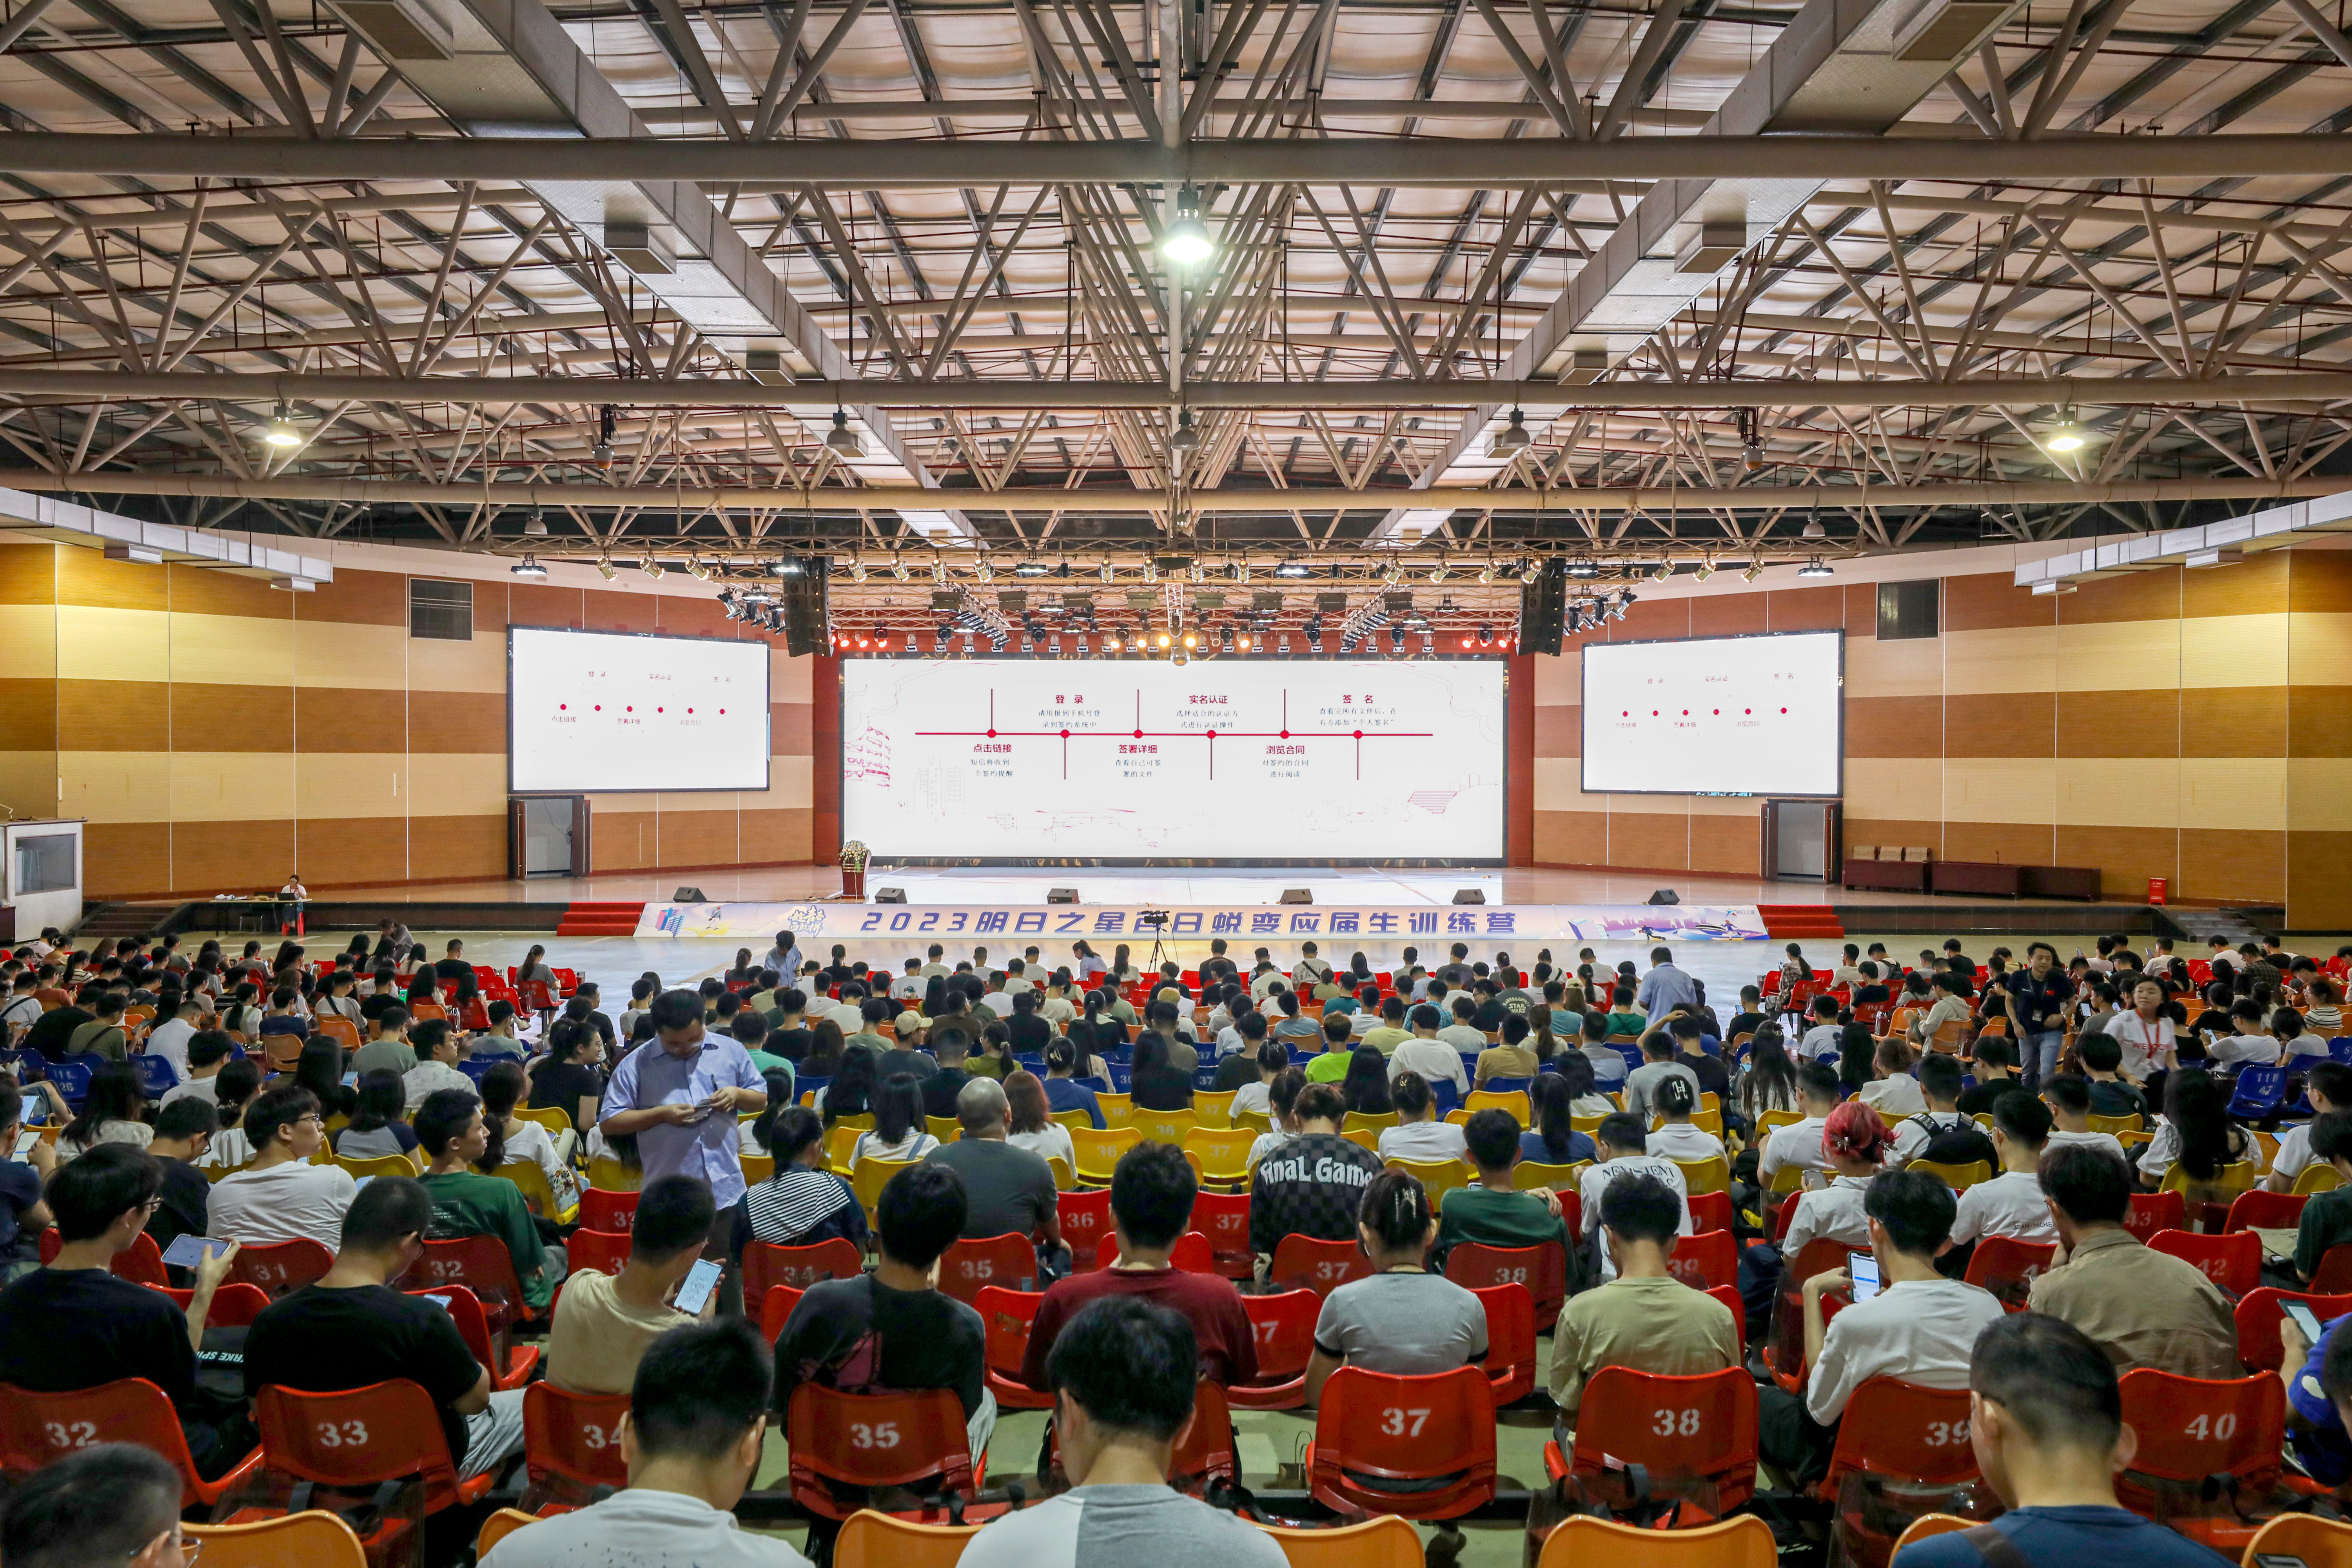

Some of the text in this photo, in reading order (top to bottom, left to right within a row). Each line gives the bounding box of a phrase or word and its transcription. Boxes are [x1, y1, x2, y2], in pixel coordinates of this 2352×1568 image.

[1189, 695, 1228, 704] 实名认证
[973, 743, 1012, 753] 点击链接
[1118, 744, 1157, 754] 签署详细
[1266, 745, 1305, 755] 浏览合同
[1198, 1051, 1210, 1060] 37
[59, 1082, 74, 1092] 26
[1198, 1076, 1214, 1085] 37
[1209, 1145, 1230, 1158] 37
[1316, 1157, 1373, 1187] Game
[1066, 1212, 1094, 1229] 36
[1216, 1214, 1244, 1230] 37
[2125, 1211, 2151, 1227] 43
[255, 1263, 287, 1281] 31
[430, 1261, 463, 1278] 32
[783, 1266, 815, 1283] 34
[961, 1259, 991, 1278] 35
[1317, 1261, 1349, 1280] 37
[1494, 1267, 1526, 1283] 38
[2195, 1258, 2226, 1276] 42
[218, 1352, 243, 1363] RKE
[1381, 1408, 1430, 1437] 37
[1652, 1409, 1699, 1436] 38
[2184, 1413, 2235, 1441] 40
[45, 1422, 100, 1447] 32
[318, 1421, 368, 1447] 33
[851, 1422, 899, 1448] 35
[1924, 1421, 1970, 1446] 39
